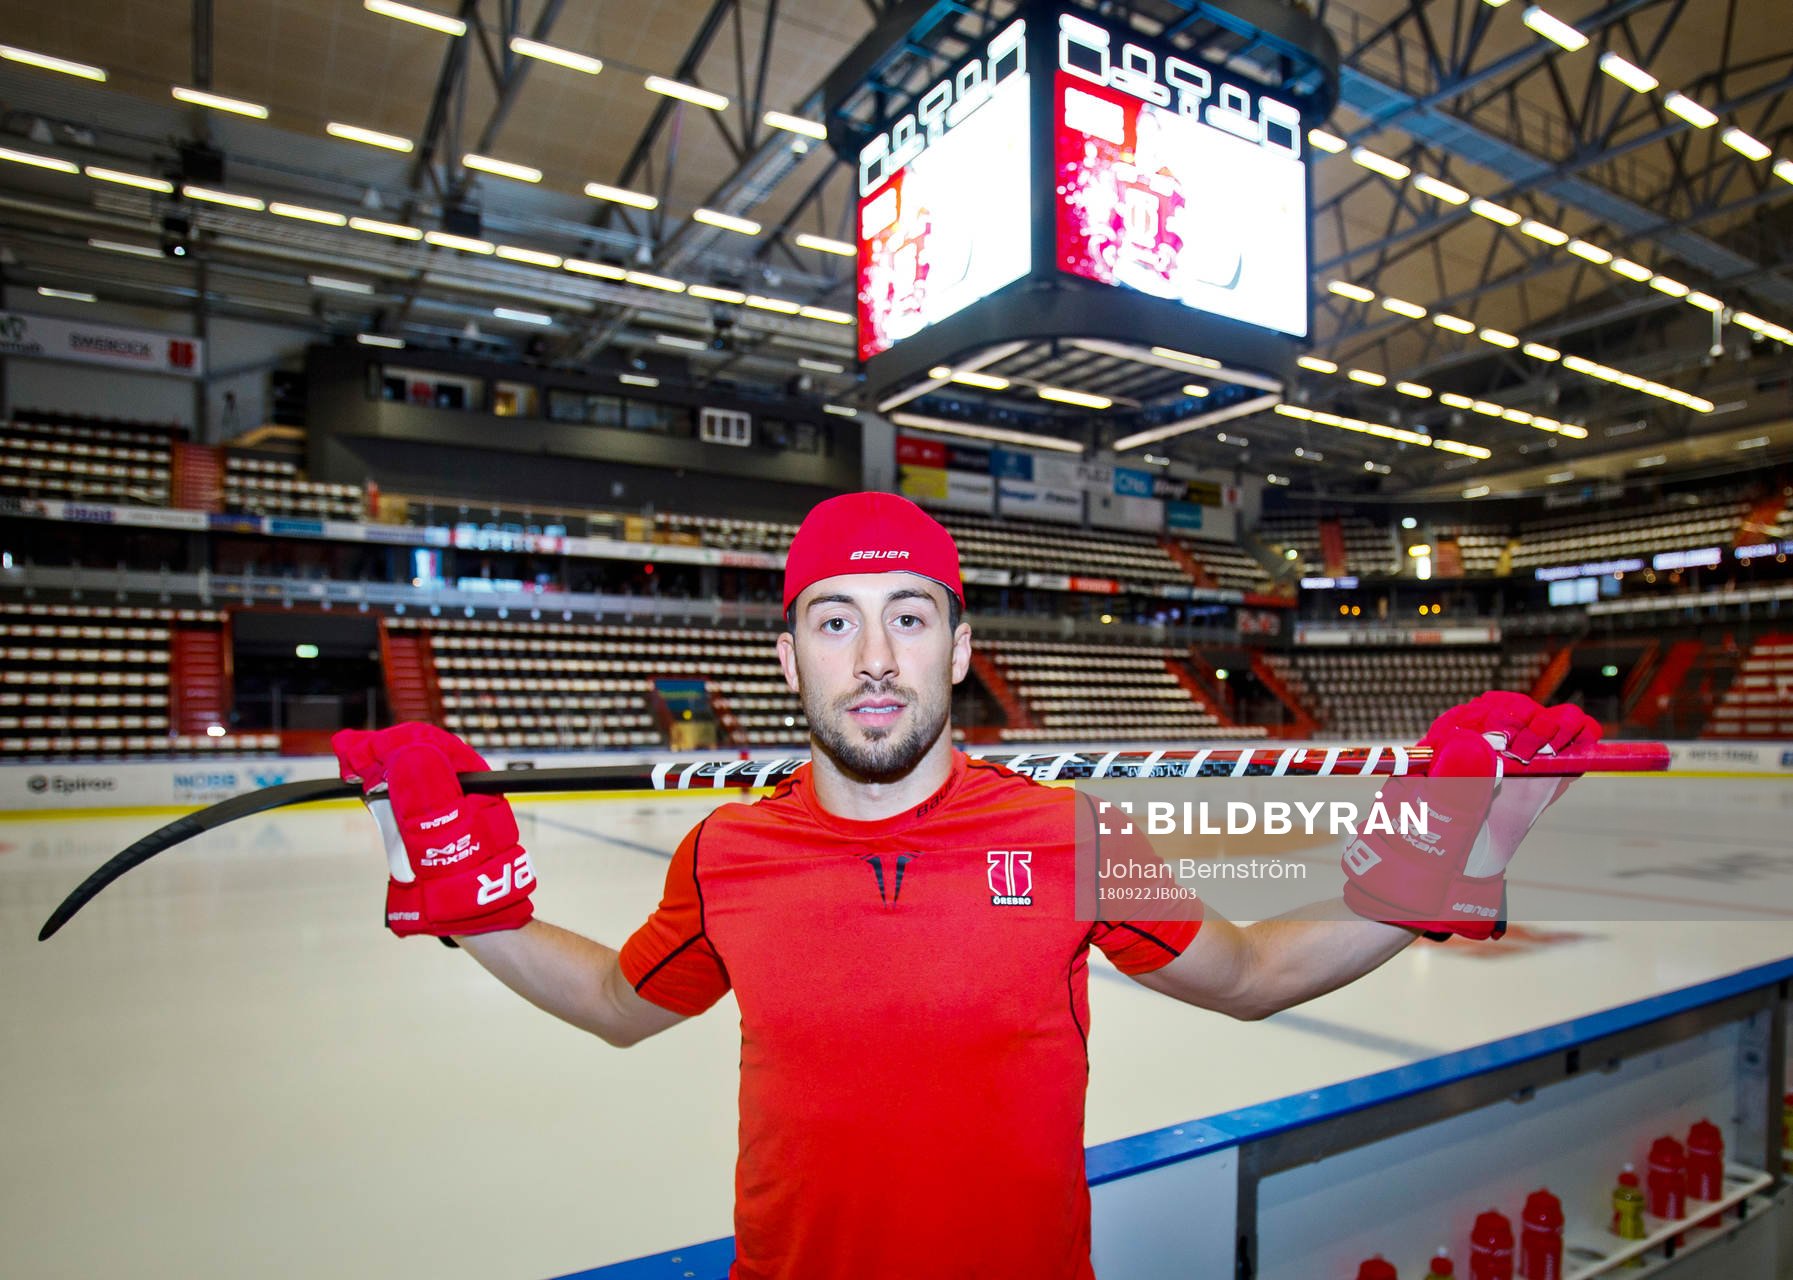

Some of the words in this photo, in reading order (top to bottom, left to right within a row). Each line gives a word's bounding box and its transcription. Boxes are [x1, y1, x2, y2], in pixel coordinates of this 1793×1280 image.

[850, 550, 910, 560] BAUER
[1127, 765, 1186, 778] PALUSAJ
[53, 775, 116, 794] Epiroc
[421, 842, 480, 867] NEXUS
[477, 852, 536, 905] ER
[993, 895, 1032, 906] ÖREBRO
[1452, 902, 1498, 918] BAUER
